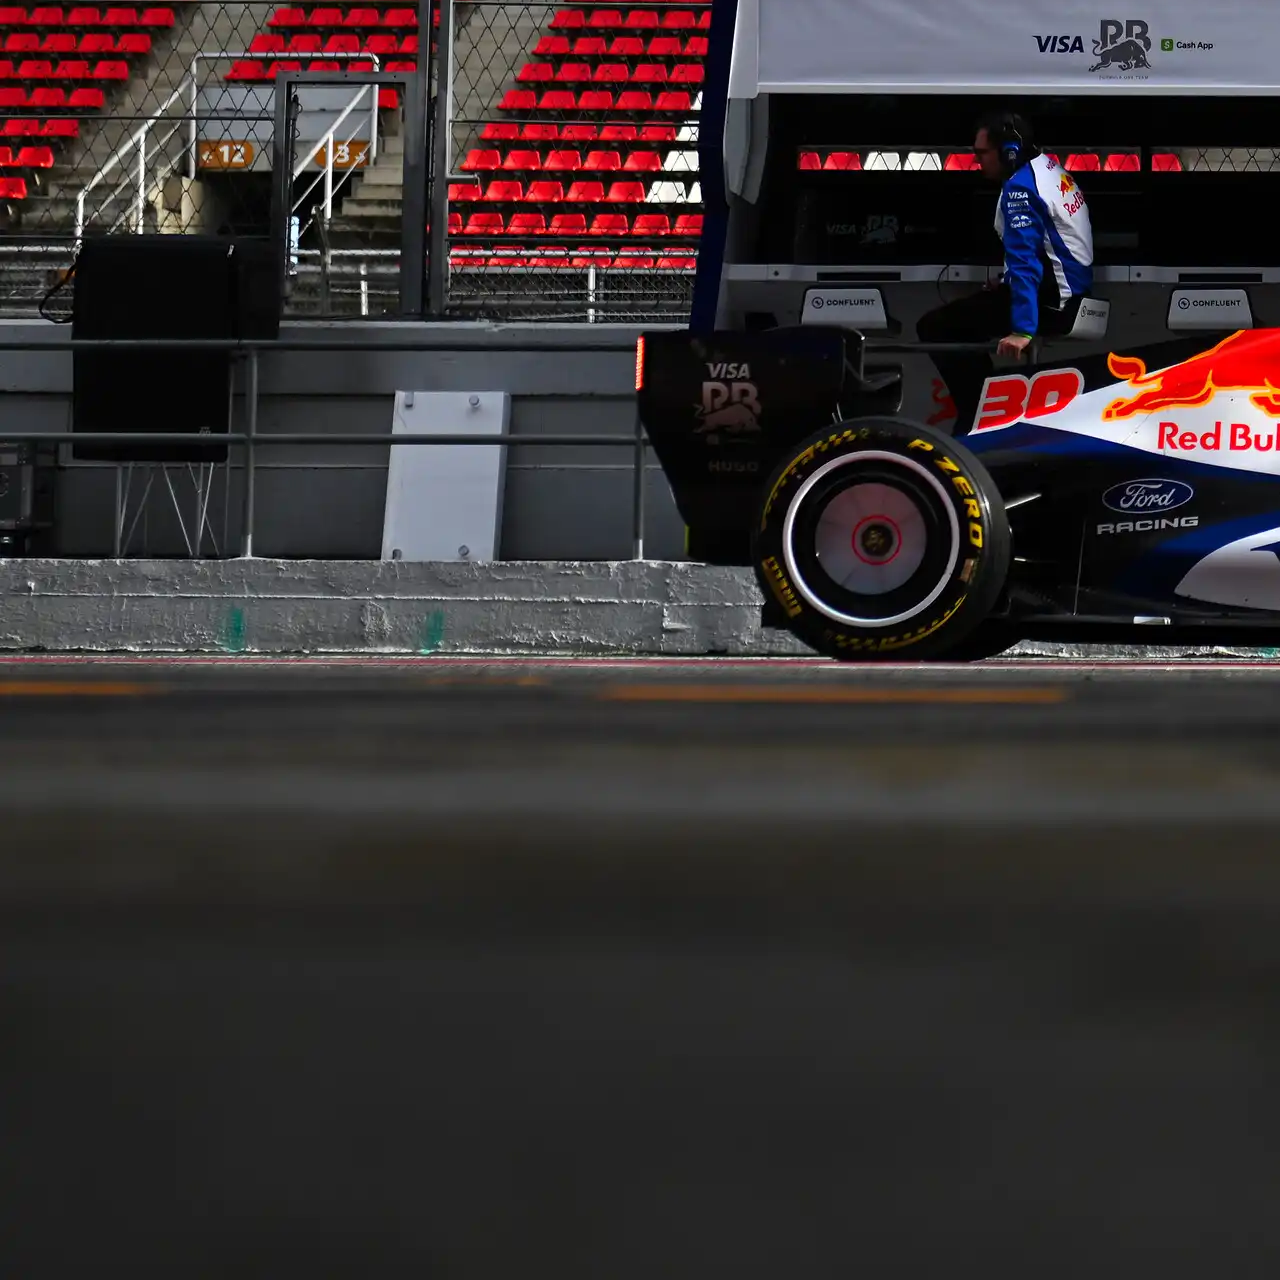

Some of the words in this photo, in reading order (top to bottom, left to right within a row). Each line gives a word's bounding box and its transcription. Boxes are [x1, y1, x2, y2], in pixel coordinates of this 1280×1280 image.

[1033, 35, 1085, 53] VISA
[1176, 41, 1196, 49] Cash
[1197, 41, 1214, 51] App
[219, 144, 246, 164] 12
[826, 298, 876, 307] CONFLUENT
[1191, 298, 1241, 308] CONFLUENT
[705, 362, 752, 380] VISA
[975, 370, 1082, 430] 30
[1157, 422, 1221, 452] Red
[708, 460, 760, 473] HUGO
[906, 438, 935, 453] P
[934, 456, 984, 550] ZERO
[1119, 481, 1176, 511] Ford
[1096, 515, 1200, 536] RACING
